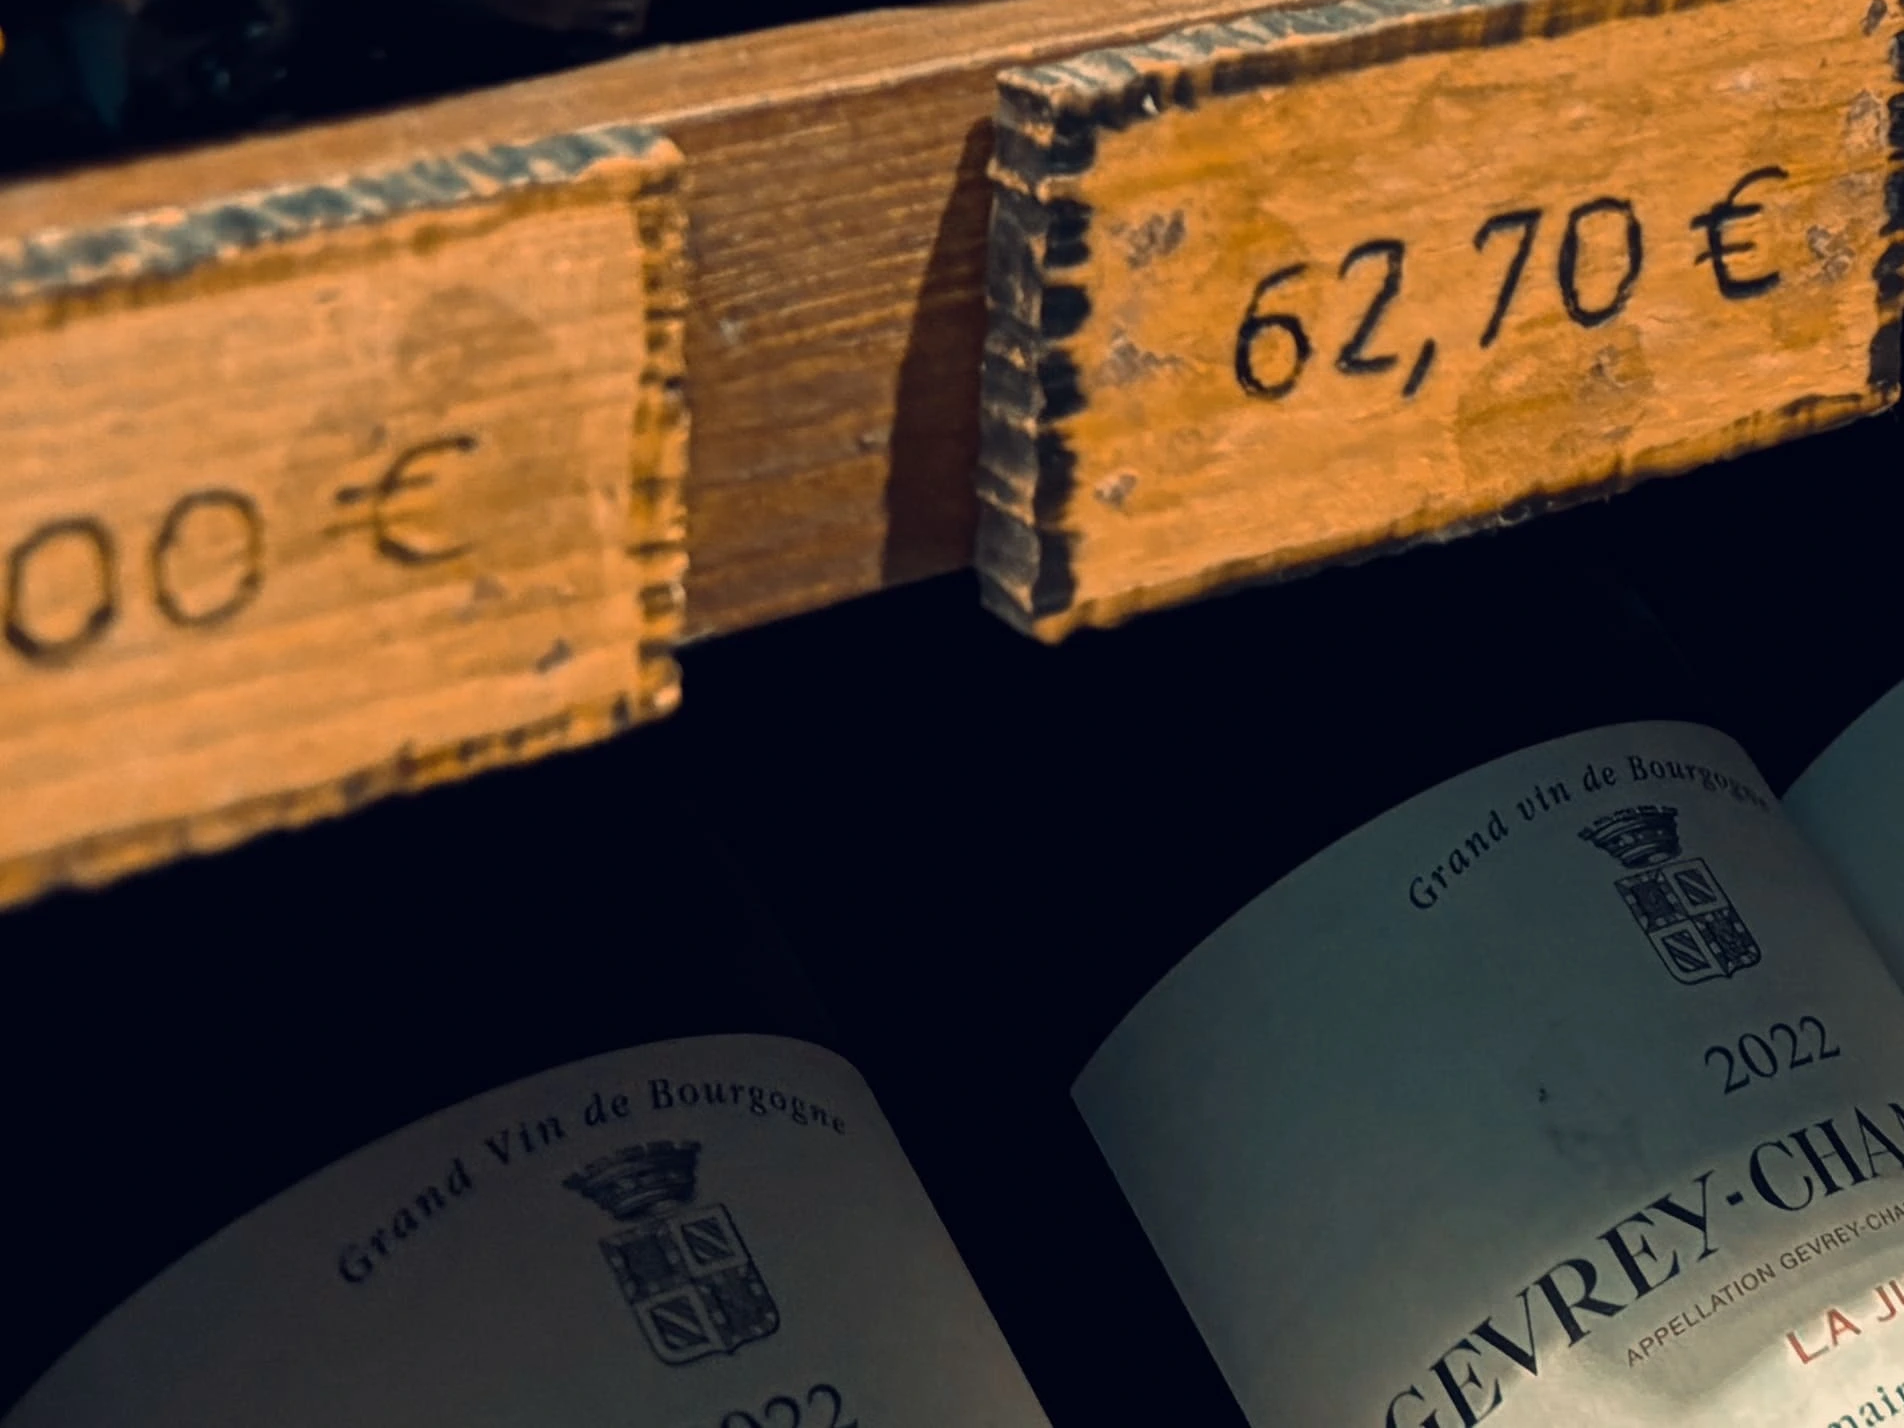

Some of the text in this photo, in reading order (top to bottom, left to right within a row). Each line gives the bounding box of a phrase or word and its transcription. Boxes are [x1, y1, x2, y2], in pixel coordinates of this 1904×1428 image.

[1234, 165, 1789, 401] 62,70 €
[323, 432, 479, 566] €
[1408, 753, 1769, 911] Grand vin de Bourgogne
[1704, 1013, 1842, 1095] 2022
[336, 1075, 850, 1288] Grand Vin de Bourgogne
[1627, 1262, 1776, 1367] APPELLATION
[1785, 1308, 1862, 1365] LA
